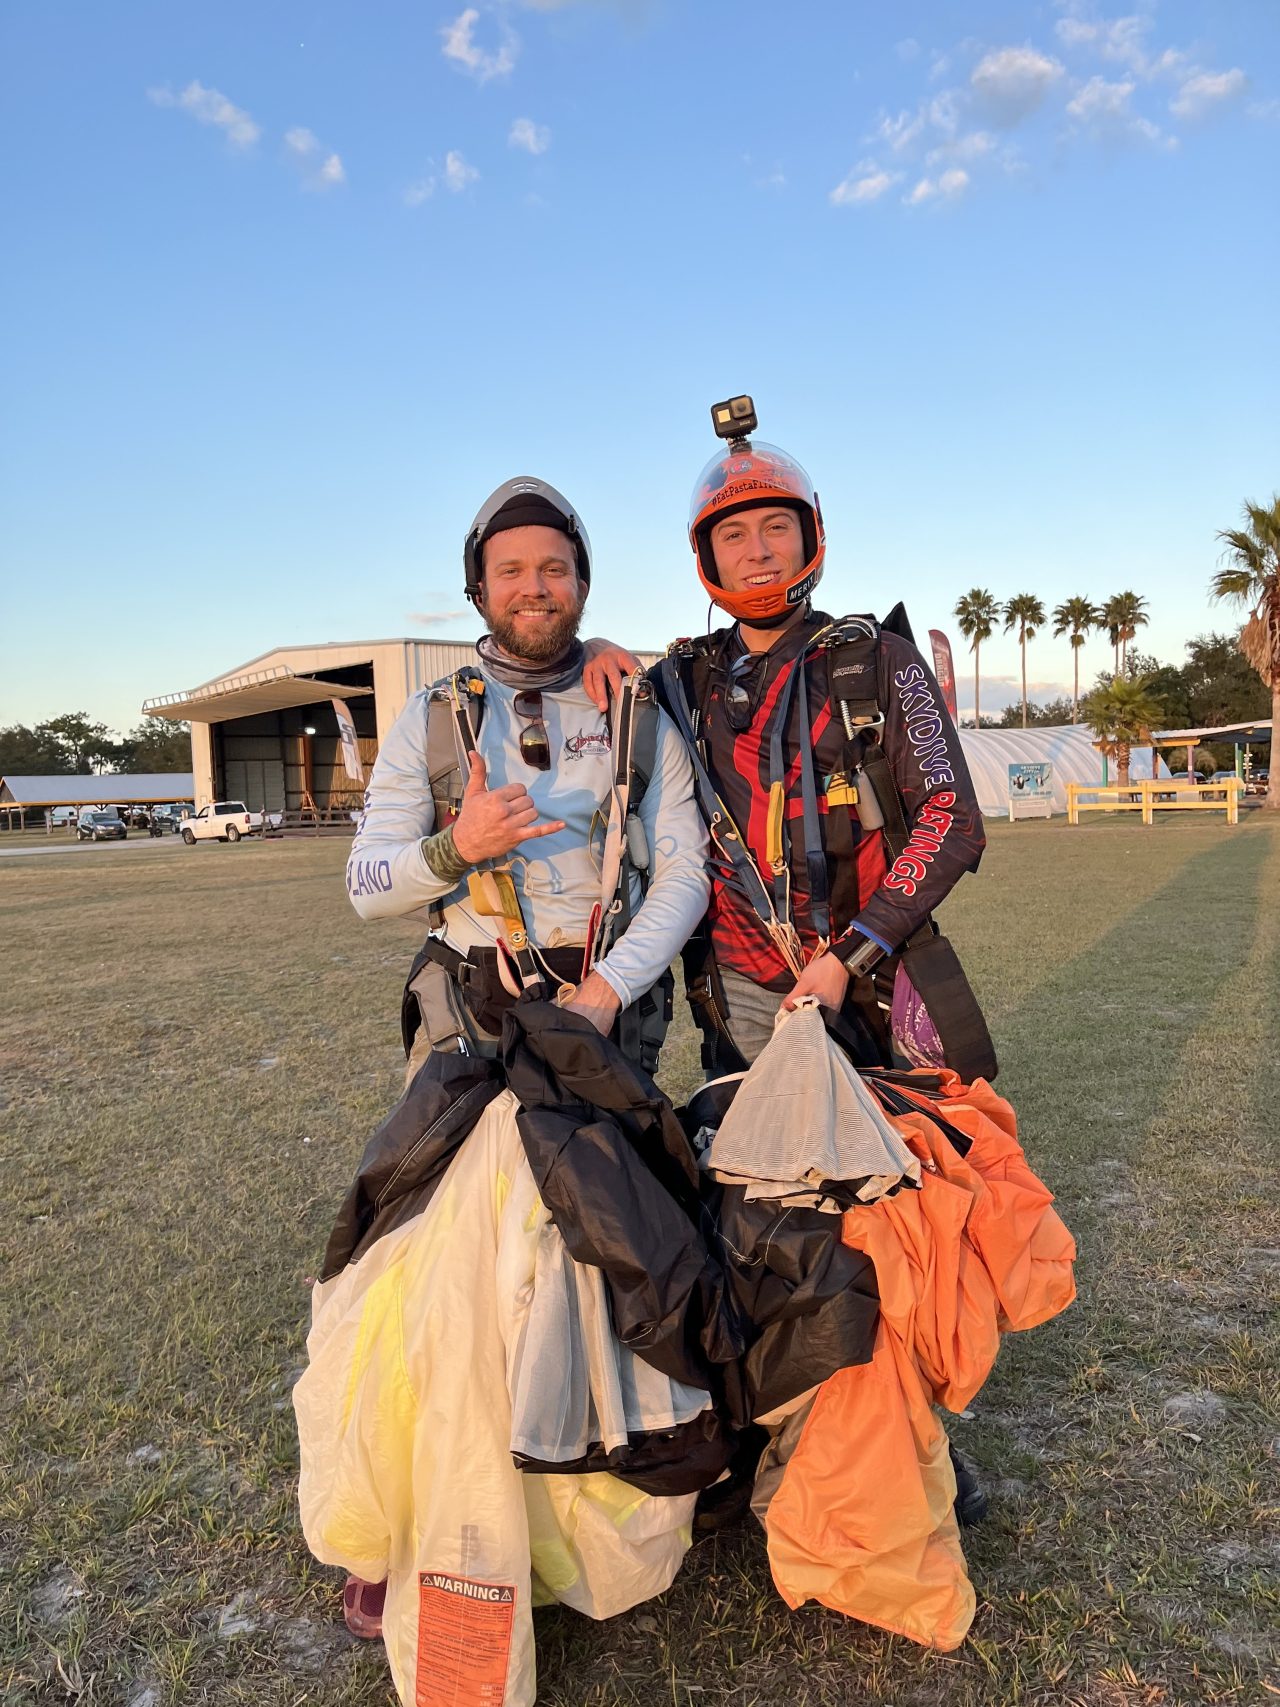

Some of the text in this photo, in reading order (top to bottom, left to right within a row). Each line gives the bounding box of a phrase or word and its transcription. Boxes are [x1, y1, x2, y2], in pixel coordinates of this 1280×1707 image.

[790, 574, 814, 601] MERIT
[883, 663, 956, 896] SKYDIVE RATINGS
[433, 1575, 500, 1601] WARNING
